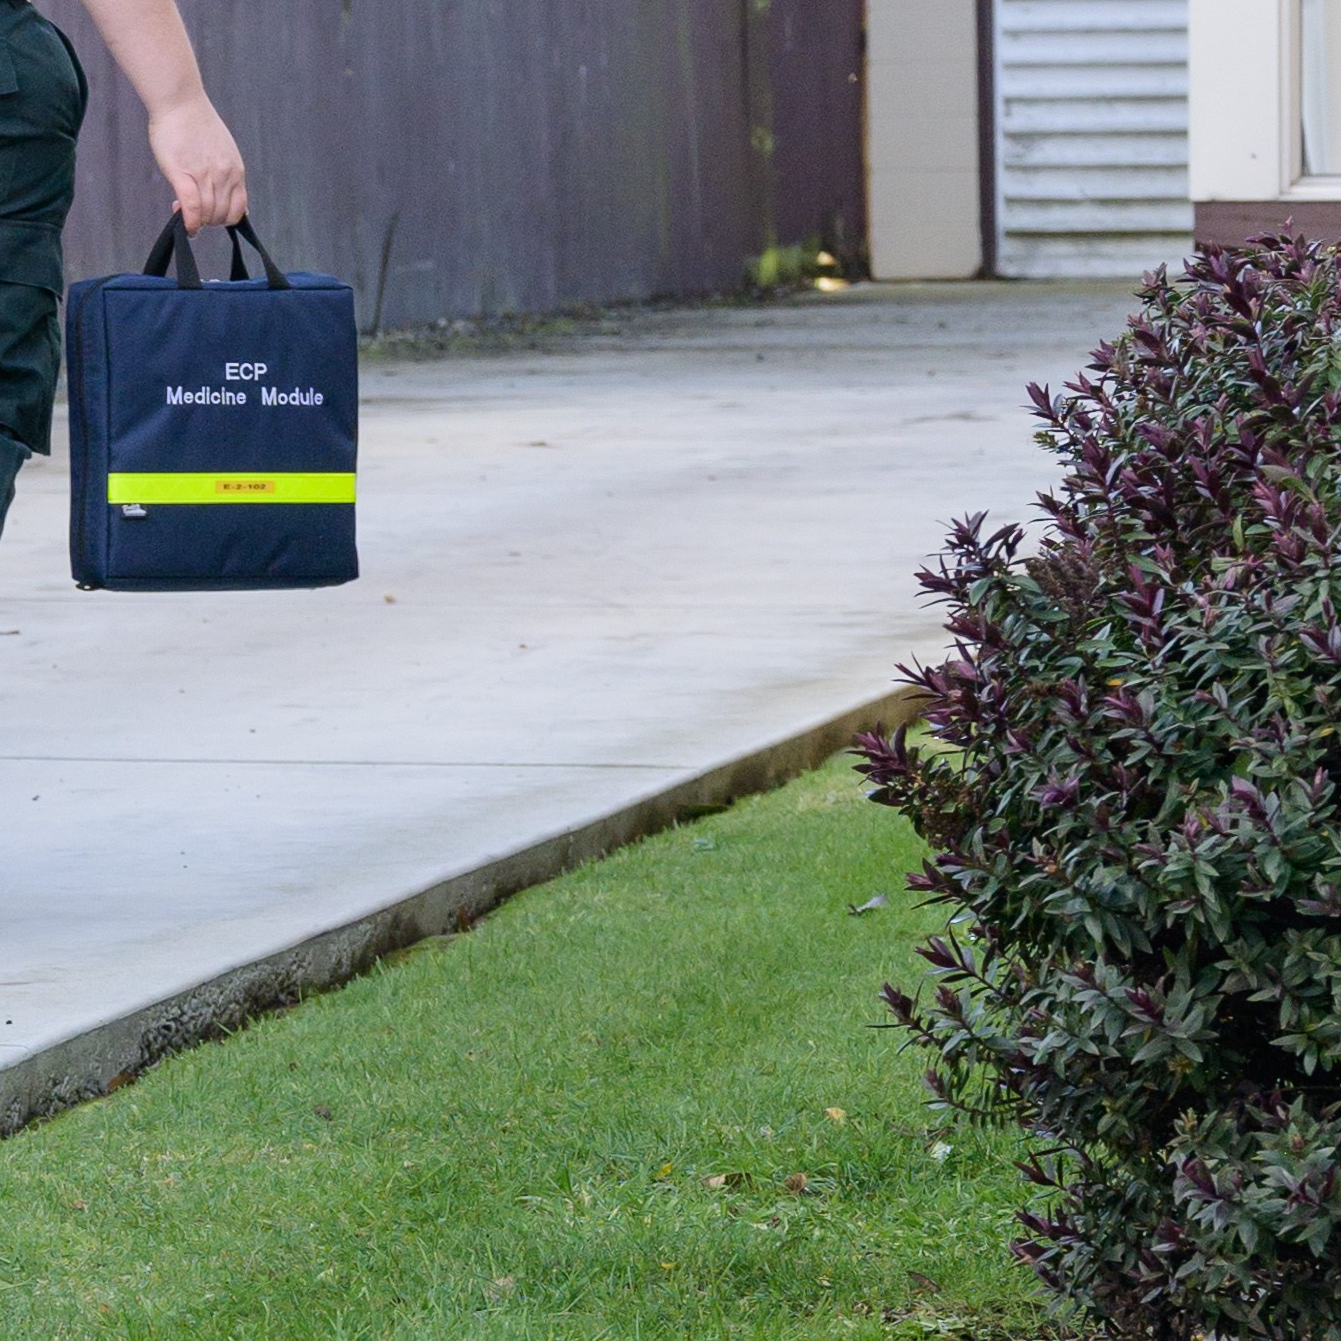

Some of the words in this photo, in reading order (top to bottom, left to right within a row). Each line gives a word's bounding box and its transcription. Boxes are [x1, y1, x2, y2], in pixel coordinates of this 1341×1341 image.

[225, 362, 267, 380] ECP
[167, 386, 247, 406] Medicine
[261, 387, 324, 406] Module
